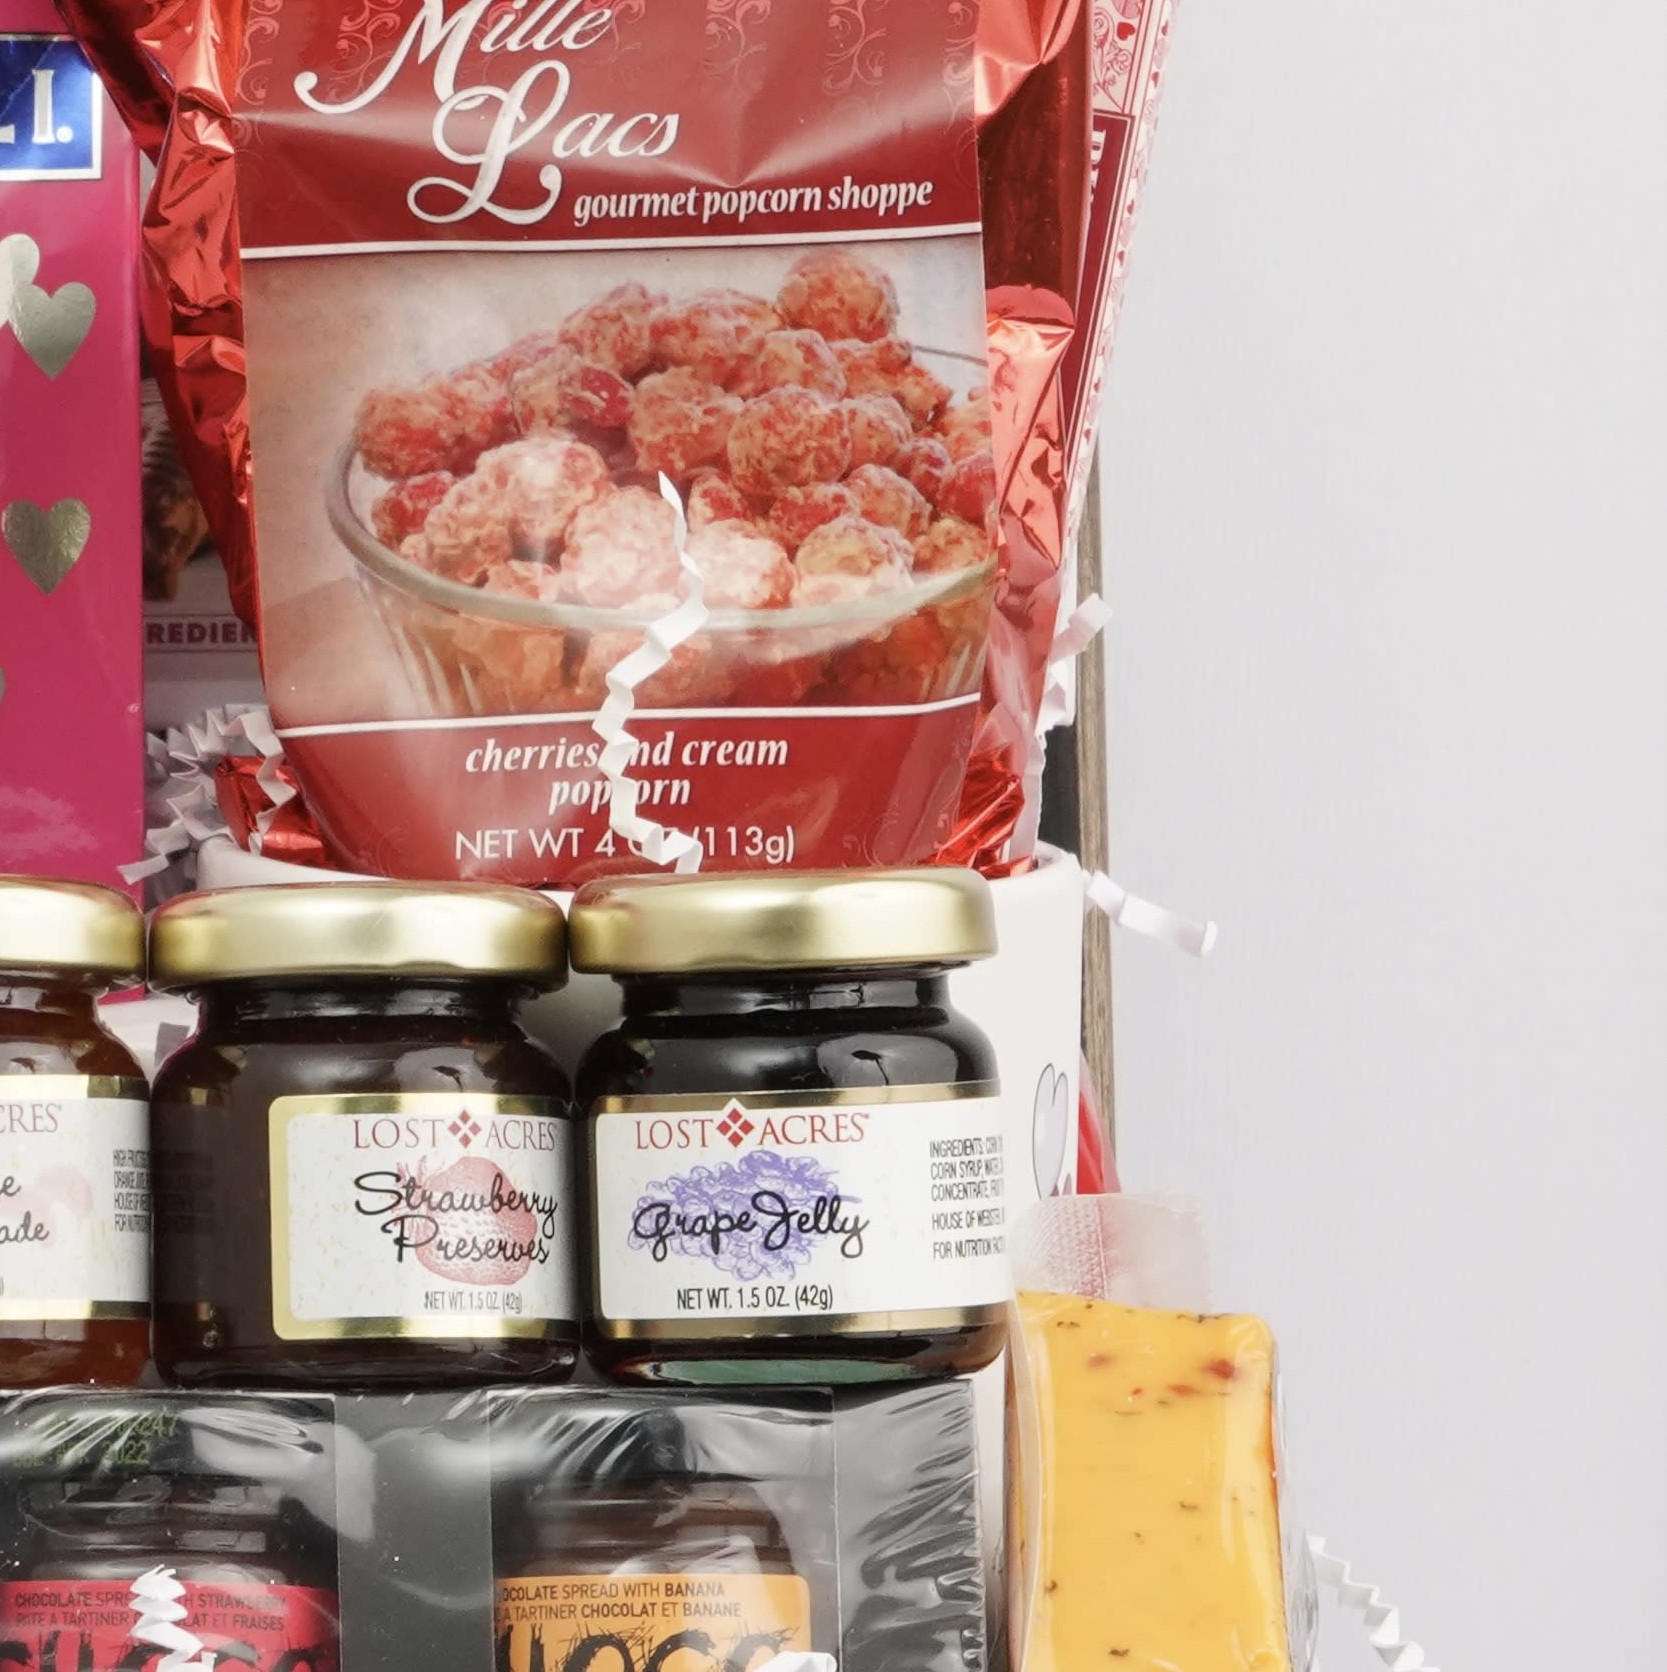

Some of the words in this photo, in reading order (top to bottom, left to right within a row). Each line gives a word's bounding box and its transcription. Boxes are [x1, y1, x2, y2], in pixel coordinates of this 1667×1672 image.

[406, 60, 679, 226] Lacs
[573, 184, 699, 228] gourmet
[703, 182, 825, 223] popcorn
[827, 175, 934, 219] shoppe
[465, 737, 600, 775] cherries
[681, 740, 788, 767] cream
[549, 778, 691, 816] poporn
[456, 831, 515, 861] NET
[531, 829, 588, 859] WT
[636, 1118, 714, 1150] LOST
[760, 1114, 864, 1146] ACRES
[353, 1171, 558, 1239] Strawberry
[380, 1214, 550, 1264] Preserves
[562, 1583, 619, 1600] SPREAD
[623, 1582, 660, 1598] WITH
[665, 1581, 725, 1598] BANANA
[515, 1605, 578, 1620] TARTINER
[581, 1602, 657, 1619] CHOCOLAT
[662, 1602, 677, 1617] ET
[683, 1602, 742, 1617] BANANE
